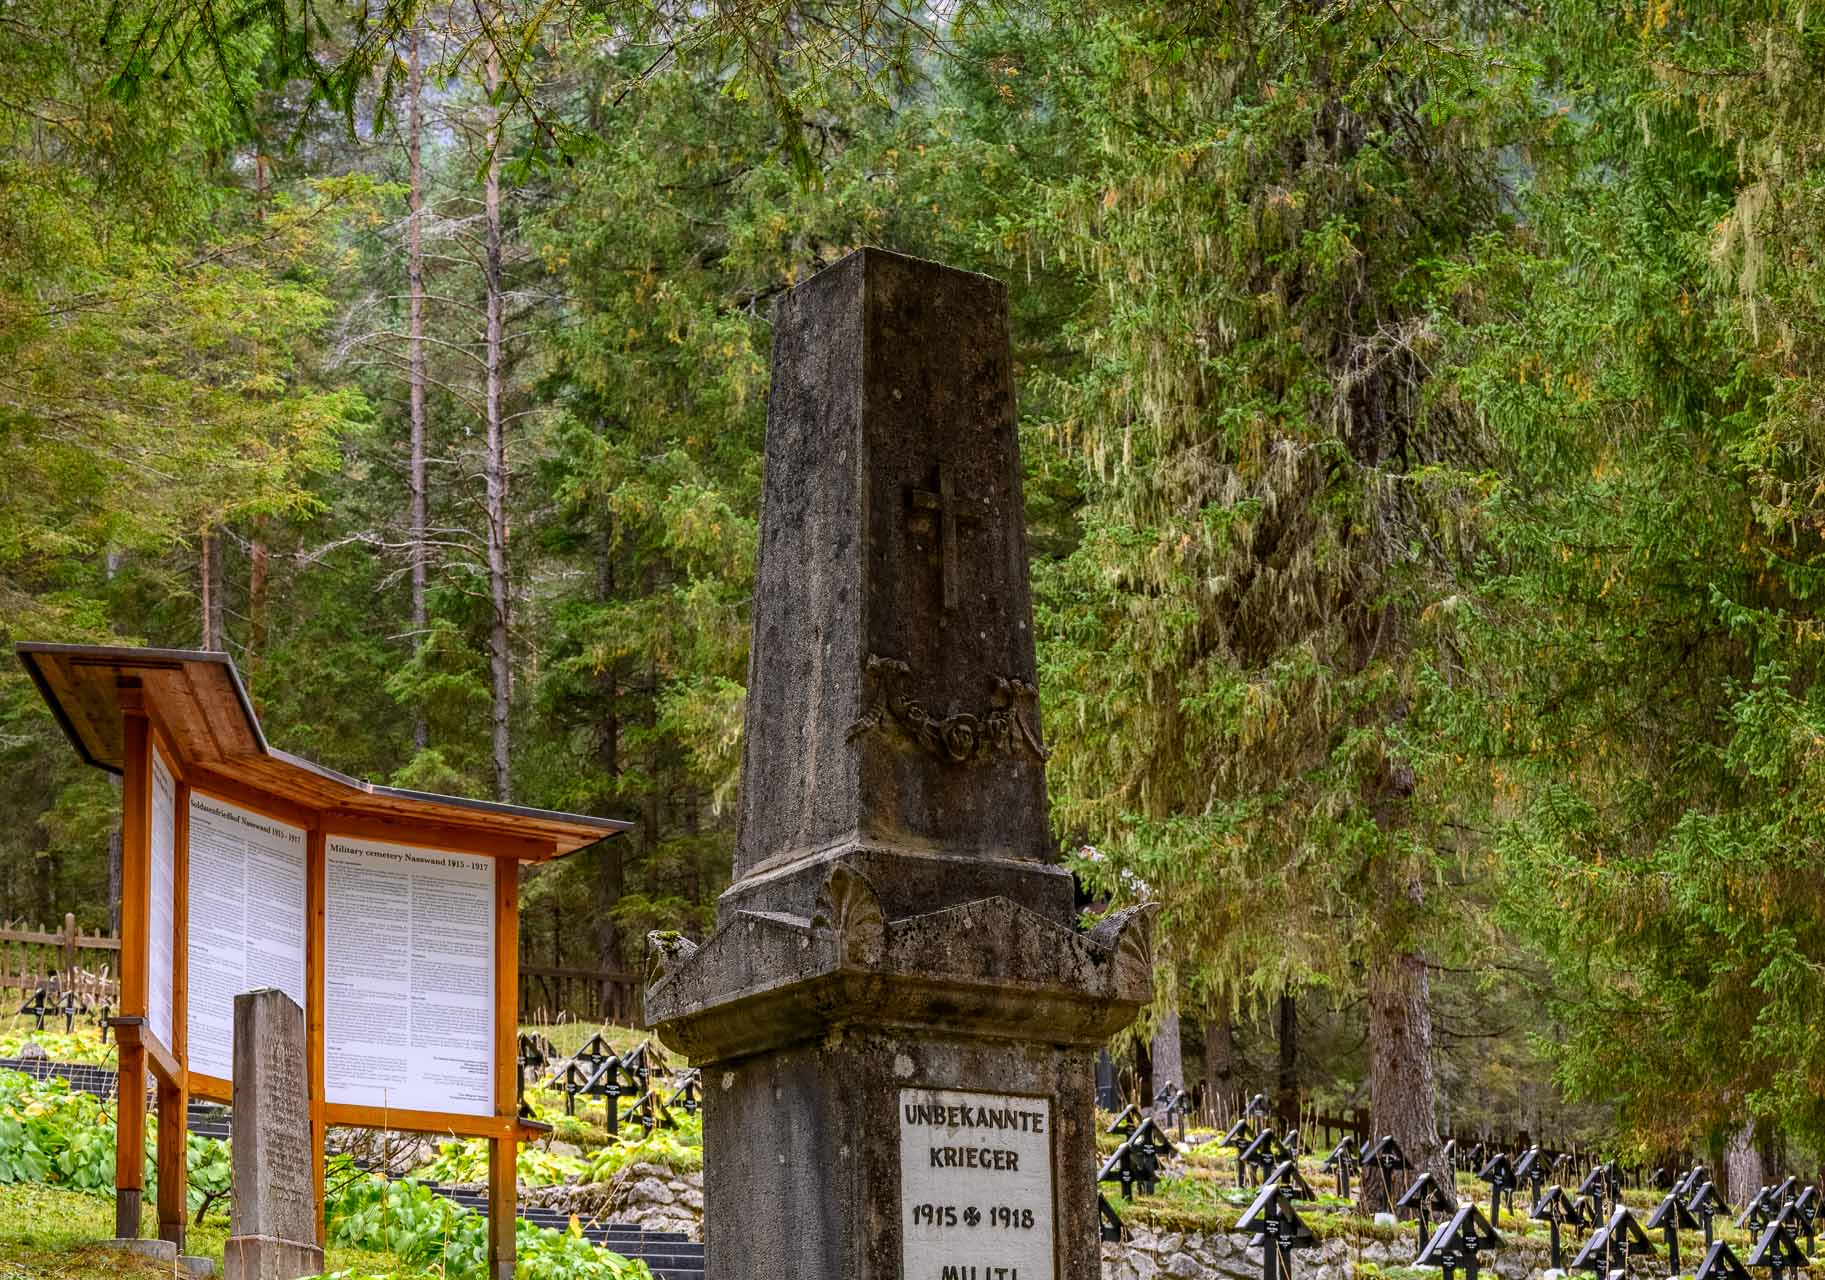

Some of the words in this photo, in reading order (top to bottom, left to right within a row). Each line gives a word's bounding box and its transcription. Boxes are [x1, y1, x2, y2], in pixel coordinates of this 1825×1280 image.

[330, 843, 363, 857] Military
[365, 849, 403, 863] cemetery
[405, 854, 446, 867] Nasswand
[448, 859, 465, 869] 1915
[472, 862, 489, 871] 1917
[905, 1103, 1044, 1134] UNBEKANNTE
[930, 1147, 1019, 1172] KRIEGER
[912, 1203, 958, 1227] 1915
[989, 1205, 1035, 1229] 1918
